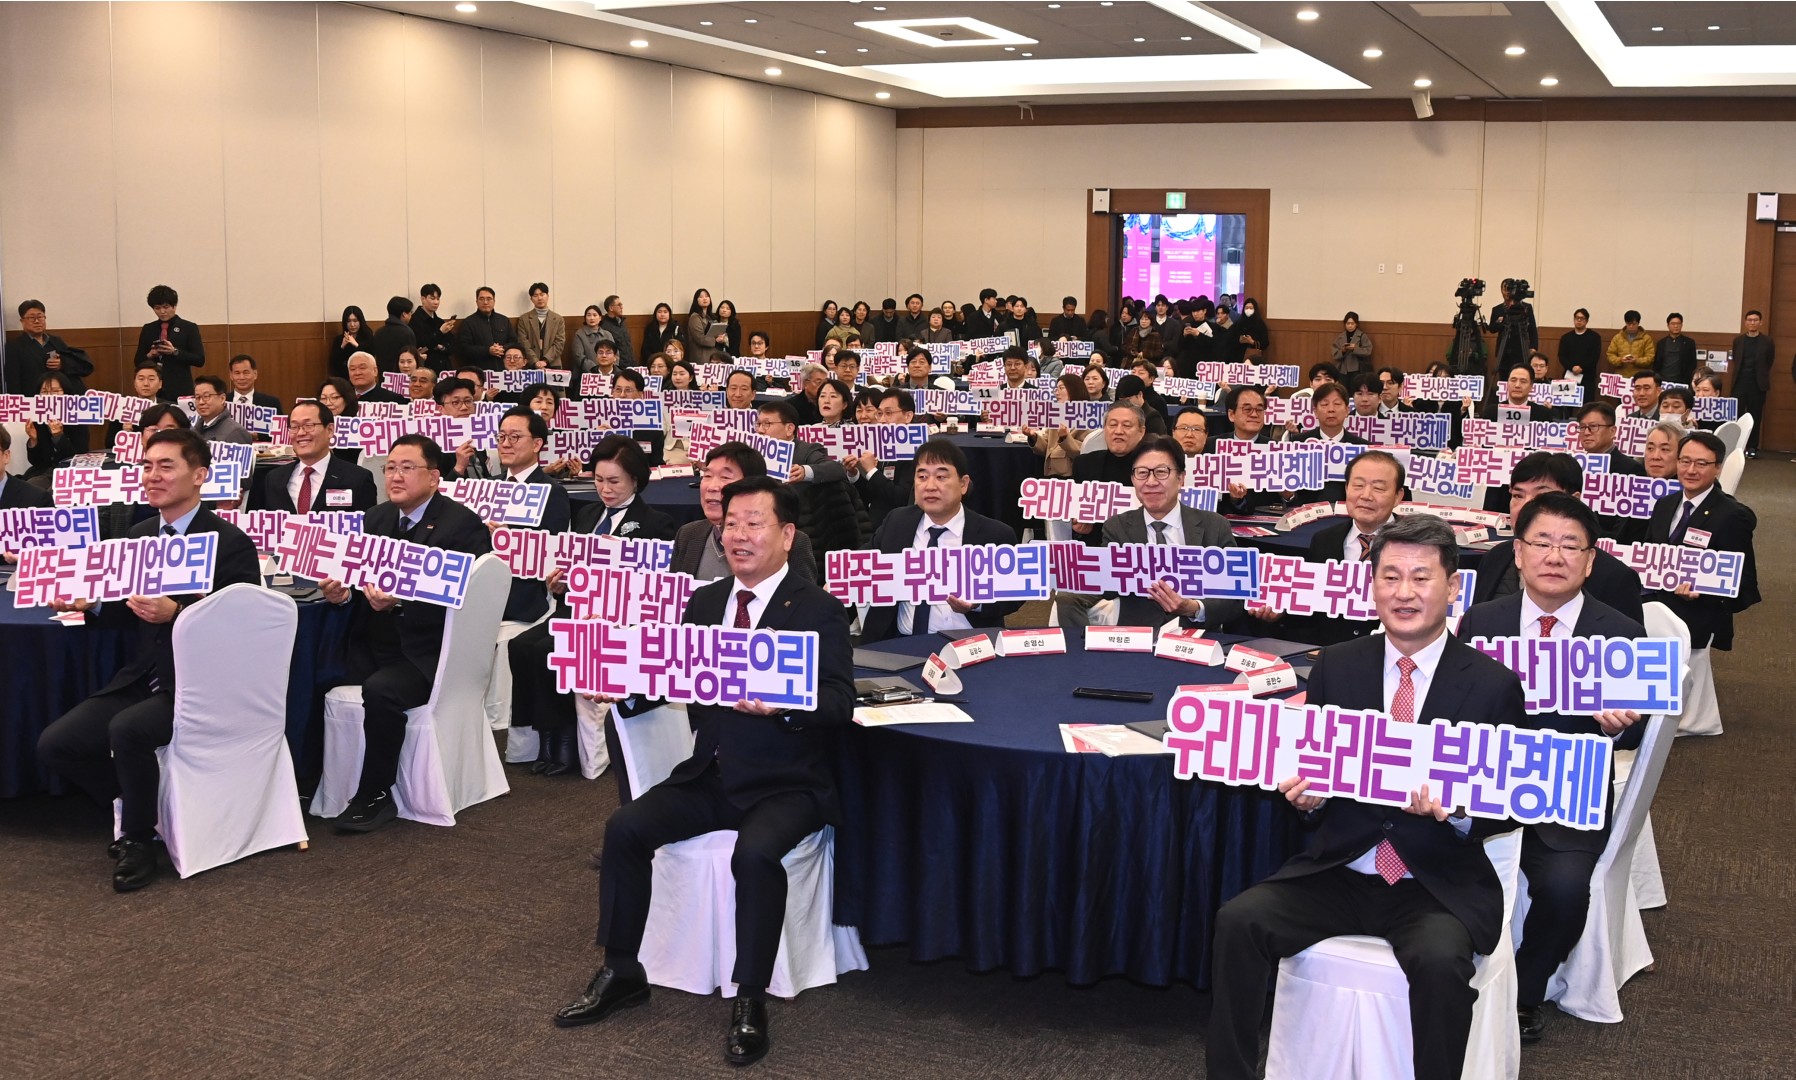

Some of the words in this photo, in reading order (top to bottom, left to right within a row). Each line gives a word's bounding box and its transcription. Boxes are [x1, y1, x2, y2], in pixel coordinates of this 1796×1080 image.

[552, 374, 563, 383] 12
[581, 374, 607, 395] 발주는
[1197, 363, 1224, 383] 우리가
[1228, 364, 1256, 385] 살리는
[1259, 366, 1298, 387] 부산경제!
[1421, 378, 1482, 400] 부산상품으로!
[1558, 384, 1570, 392] 14
[1600, 374, 1627, 397] 구매는
[925, 391, 980, 414] 산기업으로!
[979, 389, 992, 398] 11
[35, 396, 103, 423] 부산기업으로!
[549, 398, 579, 429] 매는
[584, 400, 662, 429] 부산상품으로!
[991, 400, 1022, 427] 우리가
[1027, 401, 1061, 428] 살리는
[1506, 411, 1521, 420] 10
[1692, 399, 1736, 422] 부산경제!
[1391, 419, 1447, 448] 부산경제!
[1463, 420, 1497, 446] 발주는
[1193, 454, 1243, 493] 살리는
[1250, 452, 1324, 491] 부산경제!
[1458, 449, 1503, 485] 발주는
[54, 468, 112, 507] 발주는
[1020, 481, 1073, 520] 우리가
[1079, 481, 1131, 522] 살리는
[277, 521, 337, 579] 구매는
[341, 533, 472, 606] 부산상품으로!
[493, 529, 547, 578] 우리가
[17, 548, 76, 605] 발주는
[84, 534, 216, 598] 부산기업으로!
[828, 548, 894, 604] 발주는
[904, 545, 1047, 602] 부산기업으로!
[1111, 545, 1258, 600] 부산상품으로!
[1630, 543, 1742, 595] 부산상품으로!
[566, 567, 632, 627] 우리가
[550, 622, 628, 695] 구매는
[639, 626, 815, 707] 부산상품으로!
[1167, 696, 1280, 787] 우리가
[1296, 710, 1413, 799] 살리는
[1429, 724, 1609, 823] 부산경제!
